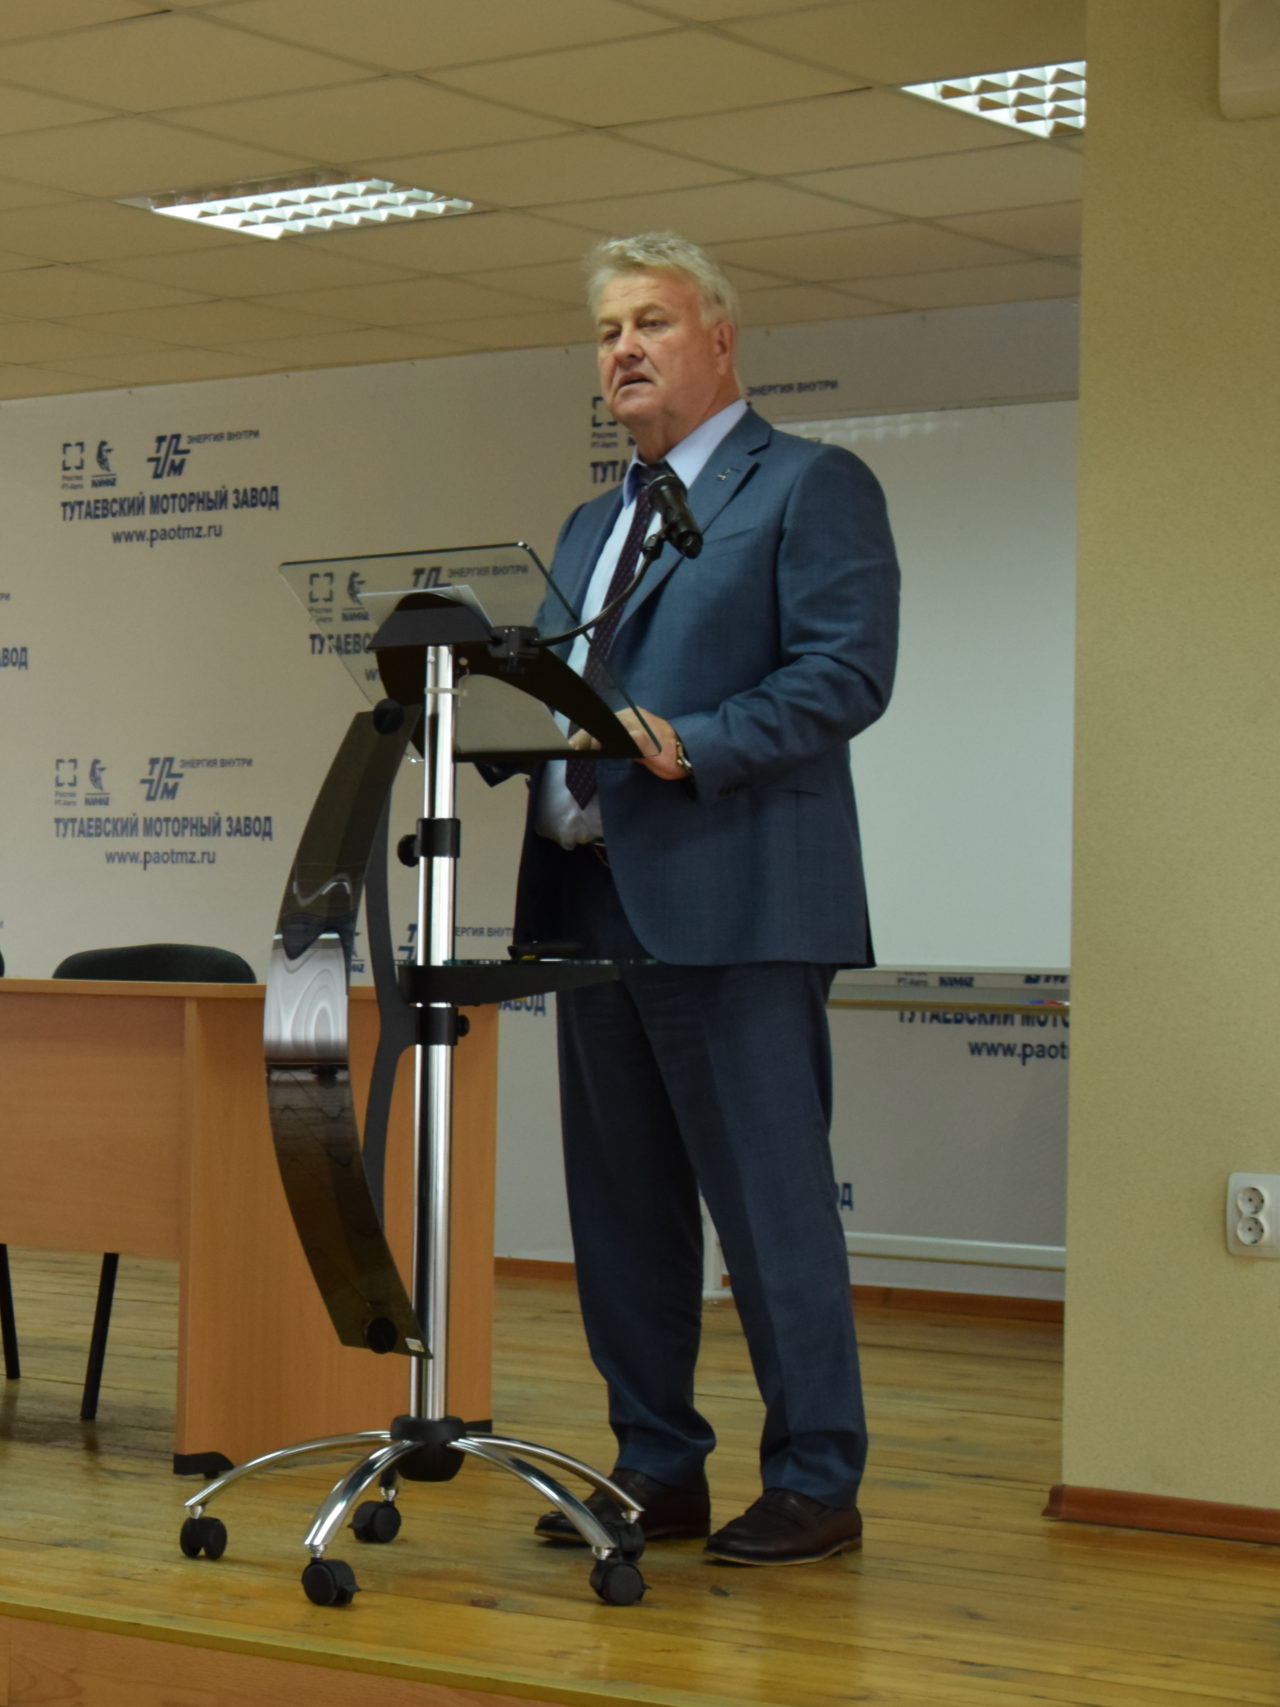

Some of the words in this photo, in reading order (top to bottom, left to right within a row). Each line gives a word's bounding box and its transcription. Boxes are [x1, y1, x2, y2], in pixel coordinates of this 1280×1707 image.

[747, 383, 795, 397] ЭНЕРГИЯ
[797, 380, 838, 393] ВНУТРИ
[61, 492, 144, 521] ТУТАЕВСКИЙ
[149, 486, 228, 515] МОТОРНЫЙ
[232, 486, 279, 510] ЗАВОД
[112, 524, 222, 547] www.paotmz.ru
[309, 632, 377, 655] ТУТАЕВС
[54, 813, 139, 838] ТУТАЕВСКИЙ
[143, 812, 222, 838] МОТОРНЫЙ
[226, 816, 273, 841] ЗАВОД
[105, 850, 216, 871] www.paotmz.ru
[455, 927, 485, 937] ЕРГИЯ
[969, 1041, 1069, 1066] www.paot
